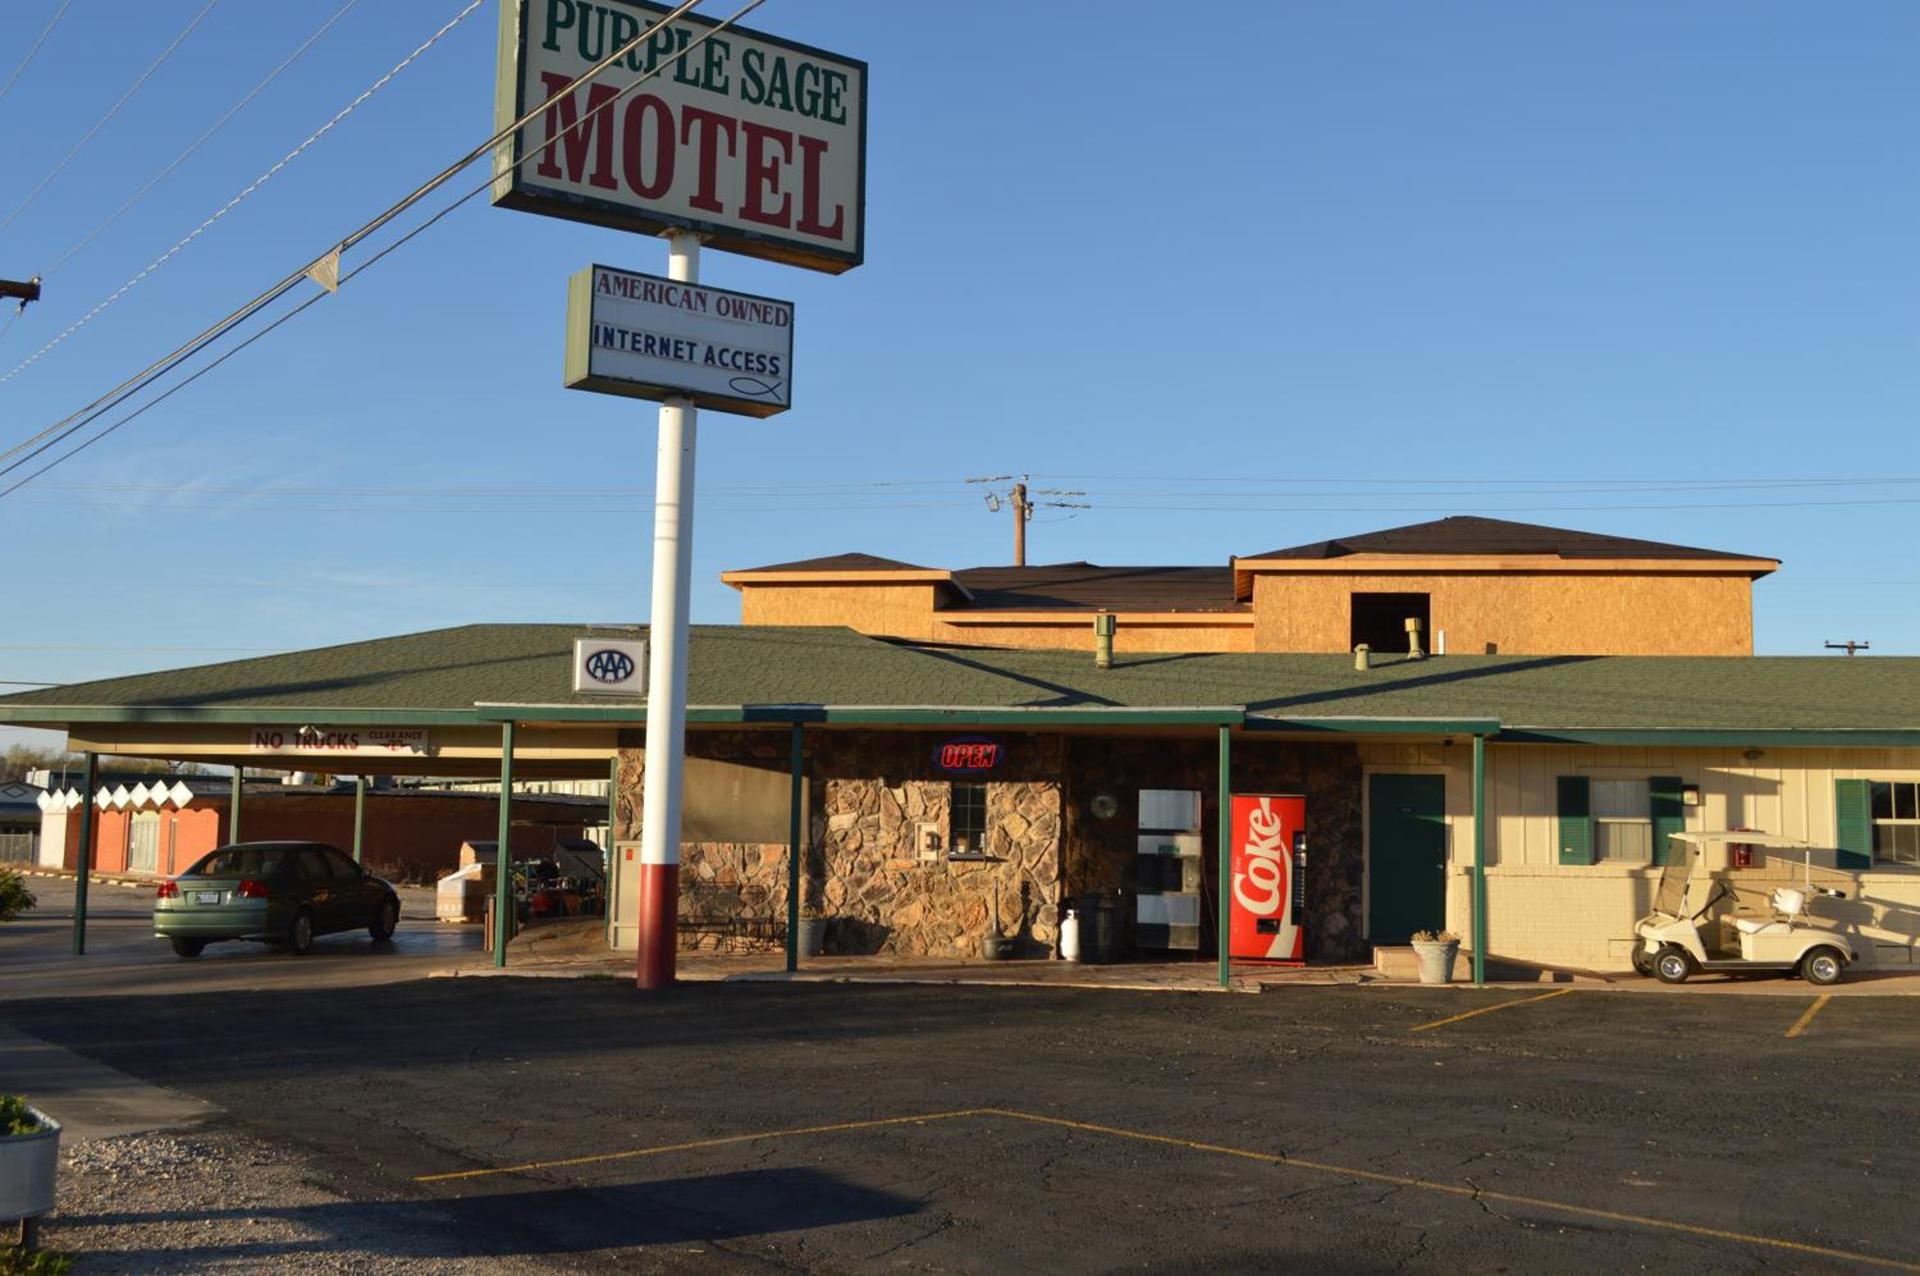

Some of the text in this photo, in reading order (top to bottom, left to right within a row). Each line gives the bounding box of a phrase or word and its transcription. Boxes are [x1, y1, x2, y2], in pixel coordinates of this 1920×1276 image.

[542, 0, 847, 126] PURPLE SAGE
[537, 71, 844, 241] MOTEL
[596, 273, 789, 328] AMERICAN OWNED
[594, 324, 781, 376] INTERNET ACCESS
[592, 651, 628, 680] AAA
[255, 732, 284, 749] NO
[293, 732, 360, 750] TRUCKS
[368, 730, 423, 740] CLEARANCE
[941, 744, 997, 768] OPEN
[1233, 797, 1281, 915] Coke
